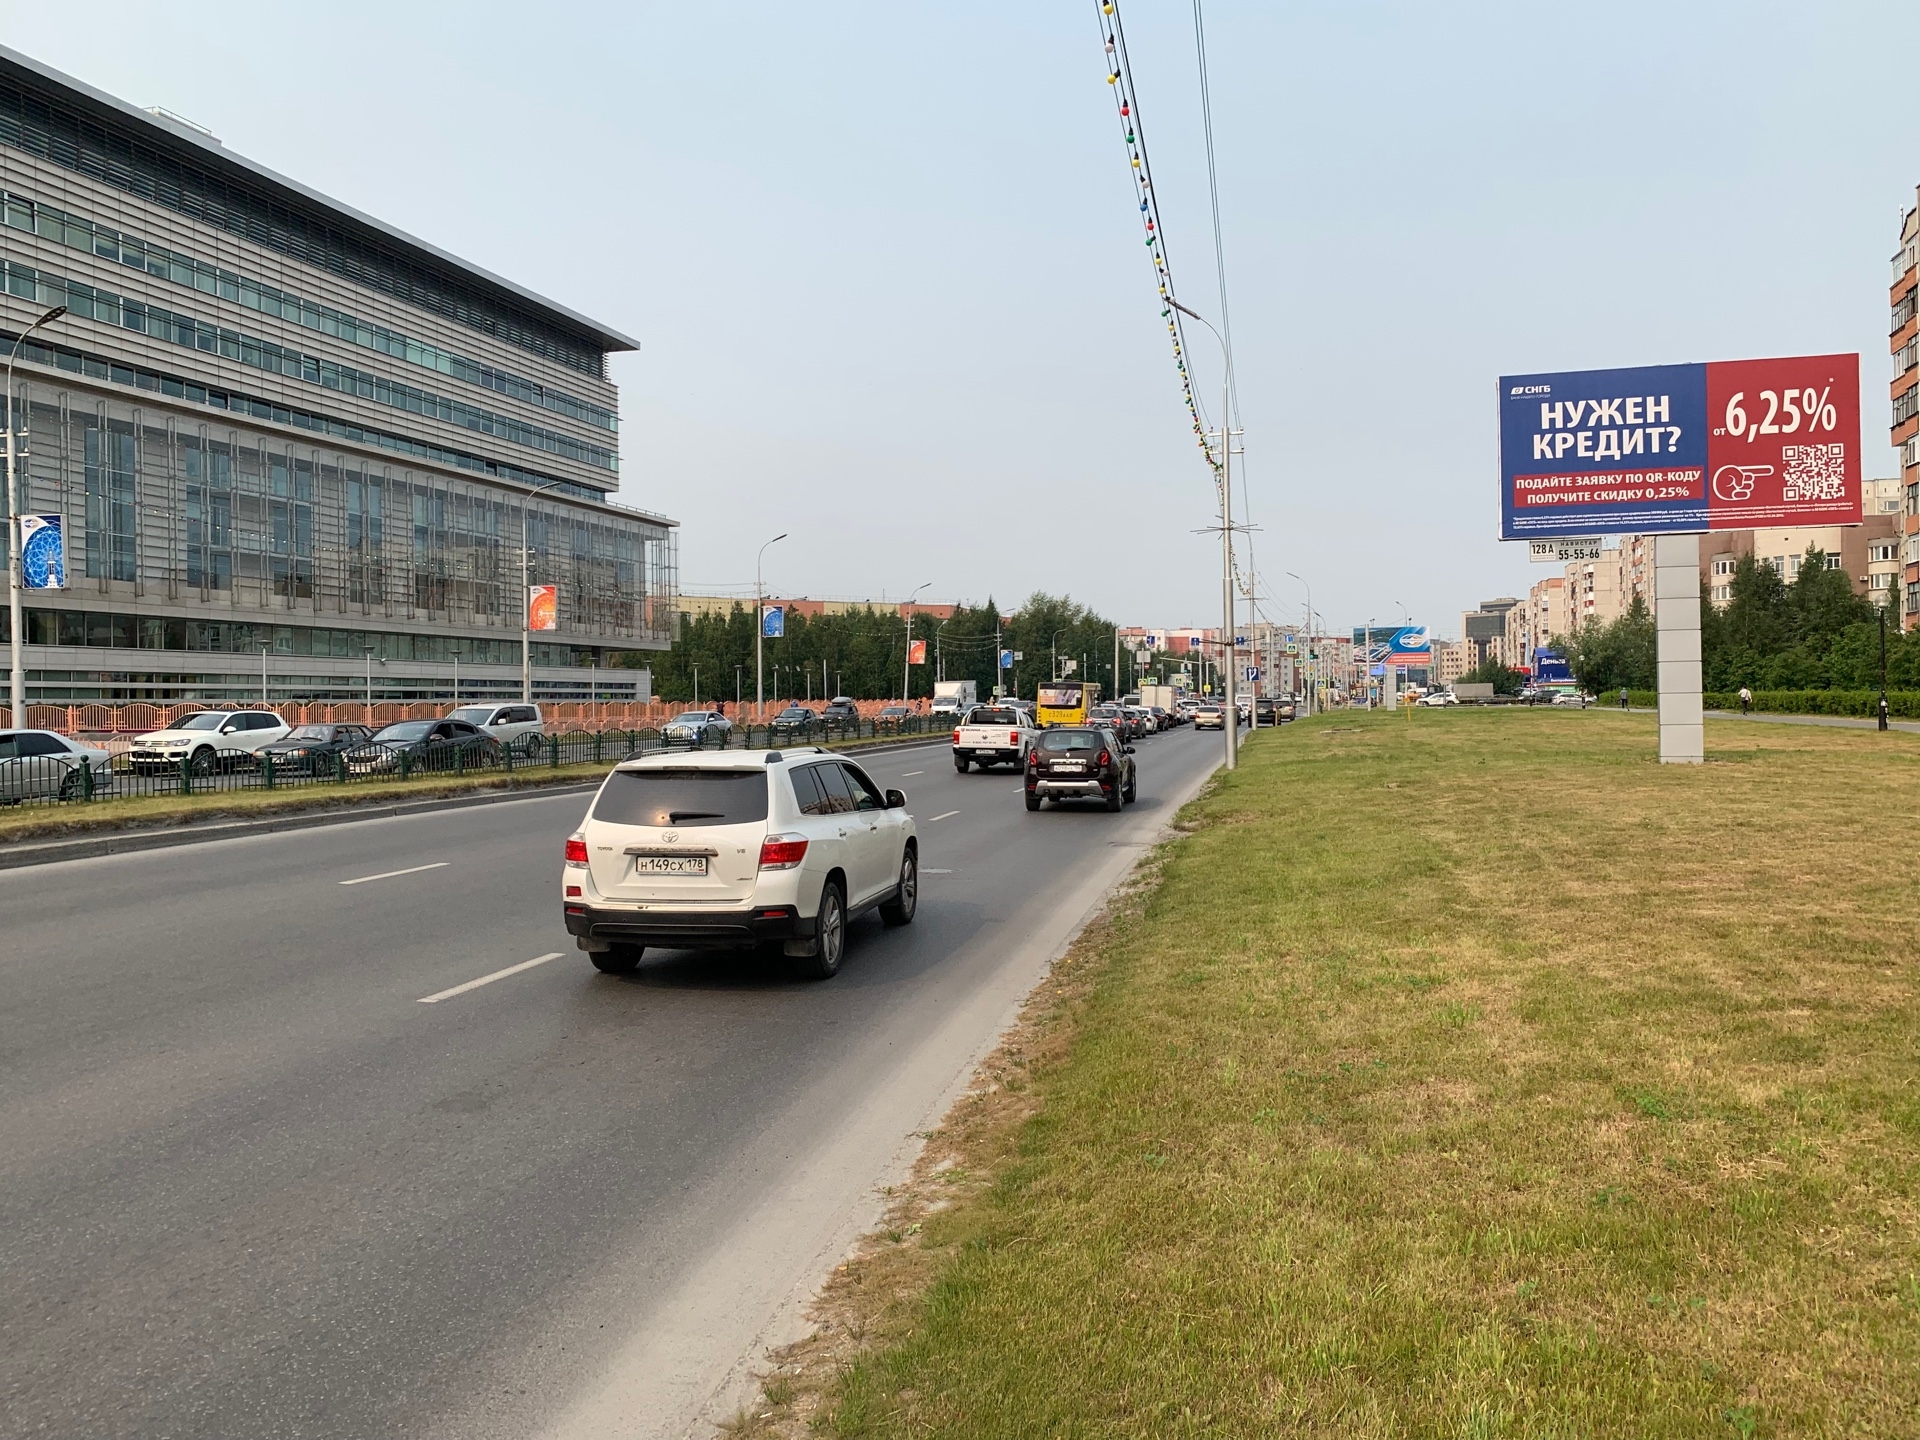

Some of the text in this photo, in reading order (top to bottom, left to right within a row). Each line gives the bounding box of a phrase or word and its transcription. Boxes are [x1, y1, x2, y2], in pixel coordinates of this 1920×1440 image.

[1525, 385, 1551, 394] СНГБ
[1540, 395, 1670, 430] НУЖЕН
[1713, 427, 1726, 436] от
[1533, 426, 1682, 462] КРЕДИТ?
[1516, 470, 1701, 490] ПОДАЙТЕ ЗАЯВКУ ПО QR-КОДУ
[1527, 486, 1690, 504] ПОЛУЧИТЕ СКИДКУ 0,25%
[1532, 544, 1547, 554] 128
[1558, 548, 1600, 560] 55-55-66
[686, 858, 704, 868] 178
